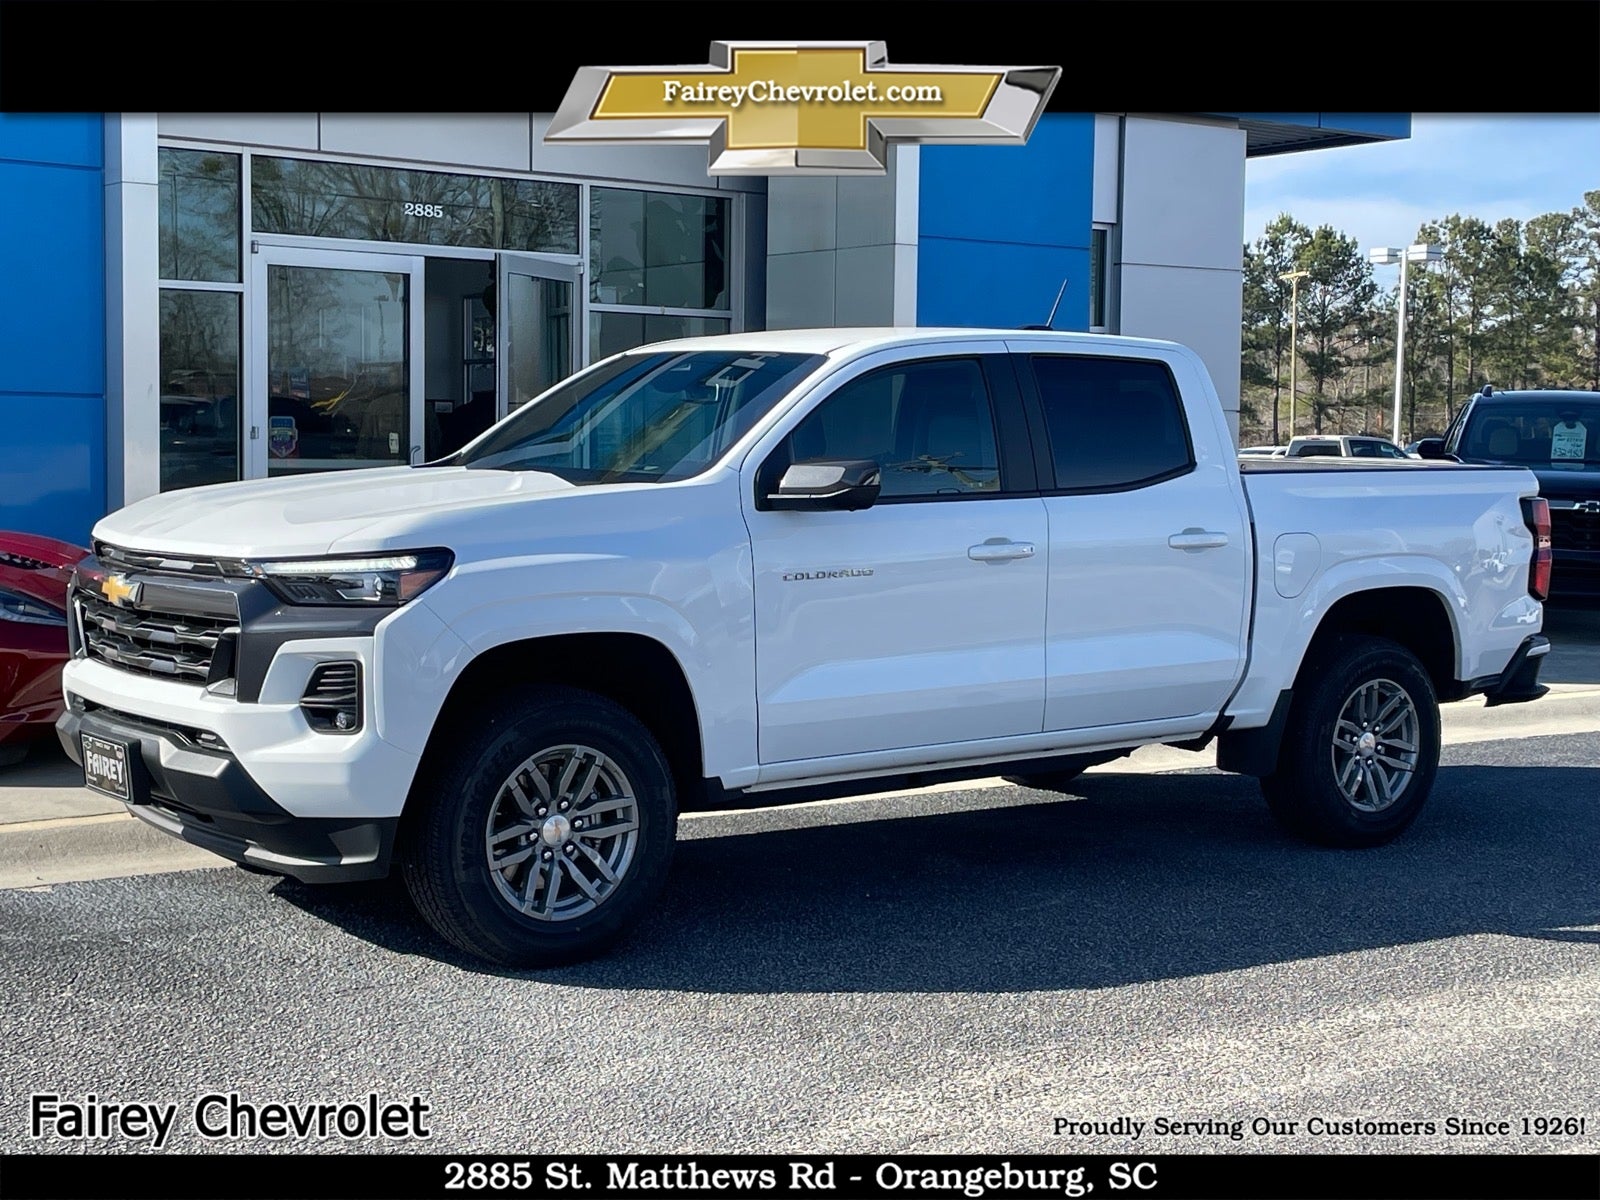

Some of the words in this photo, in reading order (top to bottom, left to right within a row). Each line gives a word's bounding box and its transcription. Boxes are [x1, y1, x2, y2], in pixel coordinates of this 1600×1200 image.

[404, 202, 443, 218] 2885
[782, 567, 874, 581] COLORADO
[86, 750, 123, 784] FAIREY
